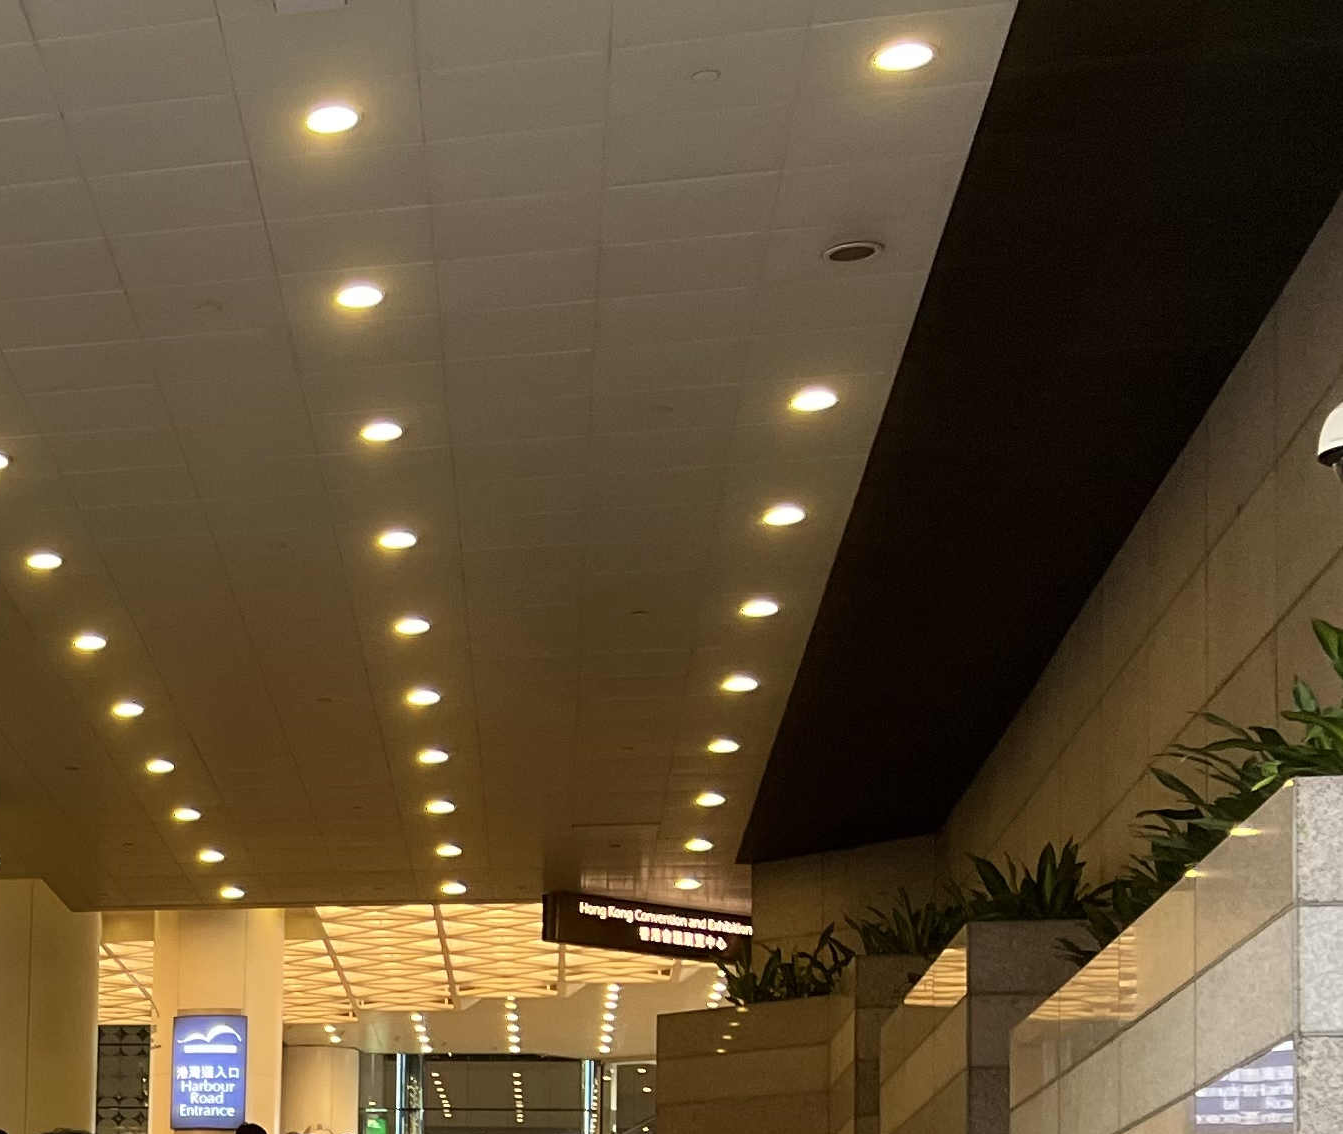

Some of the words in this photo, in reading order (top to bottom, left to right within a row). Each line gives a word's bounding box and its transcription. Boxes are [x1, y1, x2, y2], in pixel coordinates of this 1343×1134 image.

[579, 902, 607, 920] Hong
[607, 906, 634, 923] Kong
[634, 909, 688, 927] Convention
[688, 916, 708, 929] and
[708, 918, 753, 936] Exhibition
[177, 1065, 240, 1080] 港灣道入口
[181, 1079, 235, 1092] Harbour
[190, 1092, 224, 1104] Road
[180, 1103, 235, 1117] Entrance
